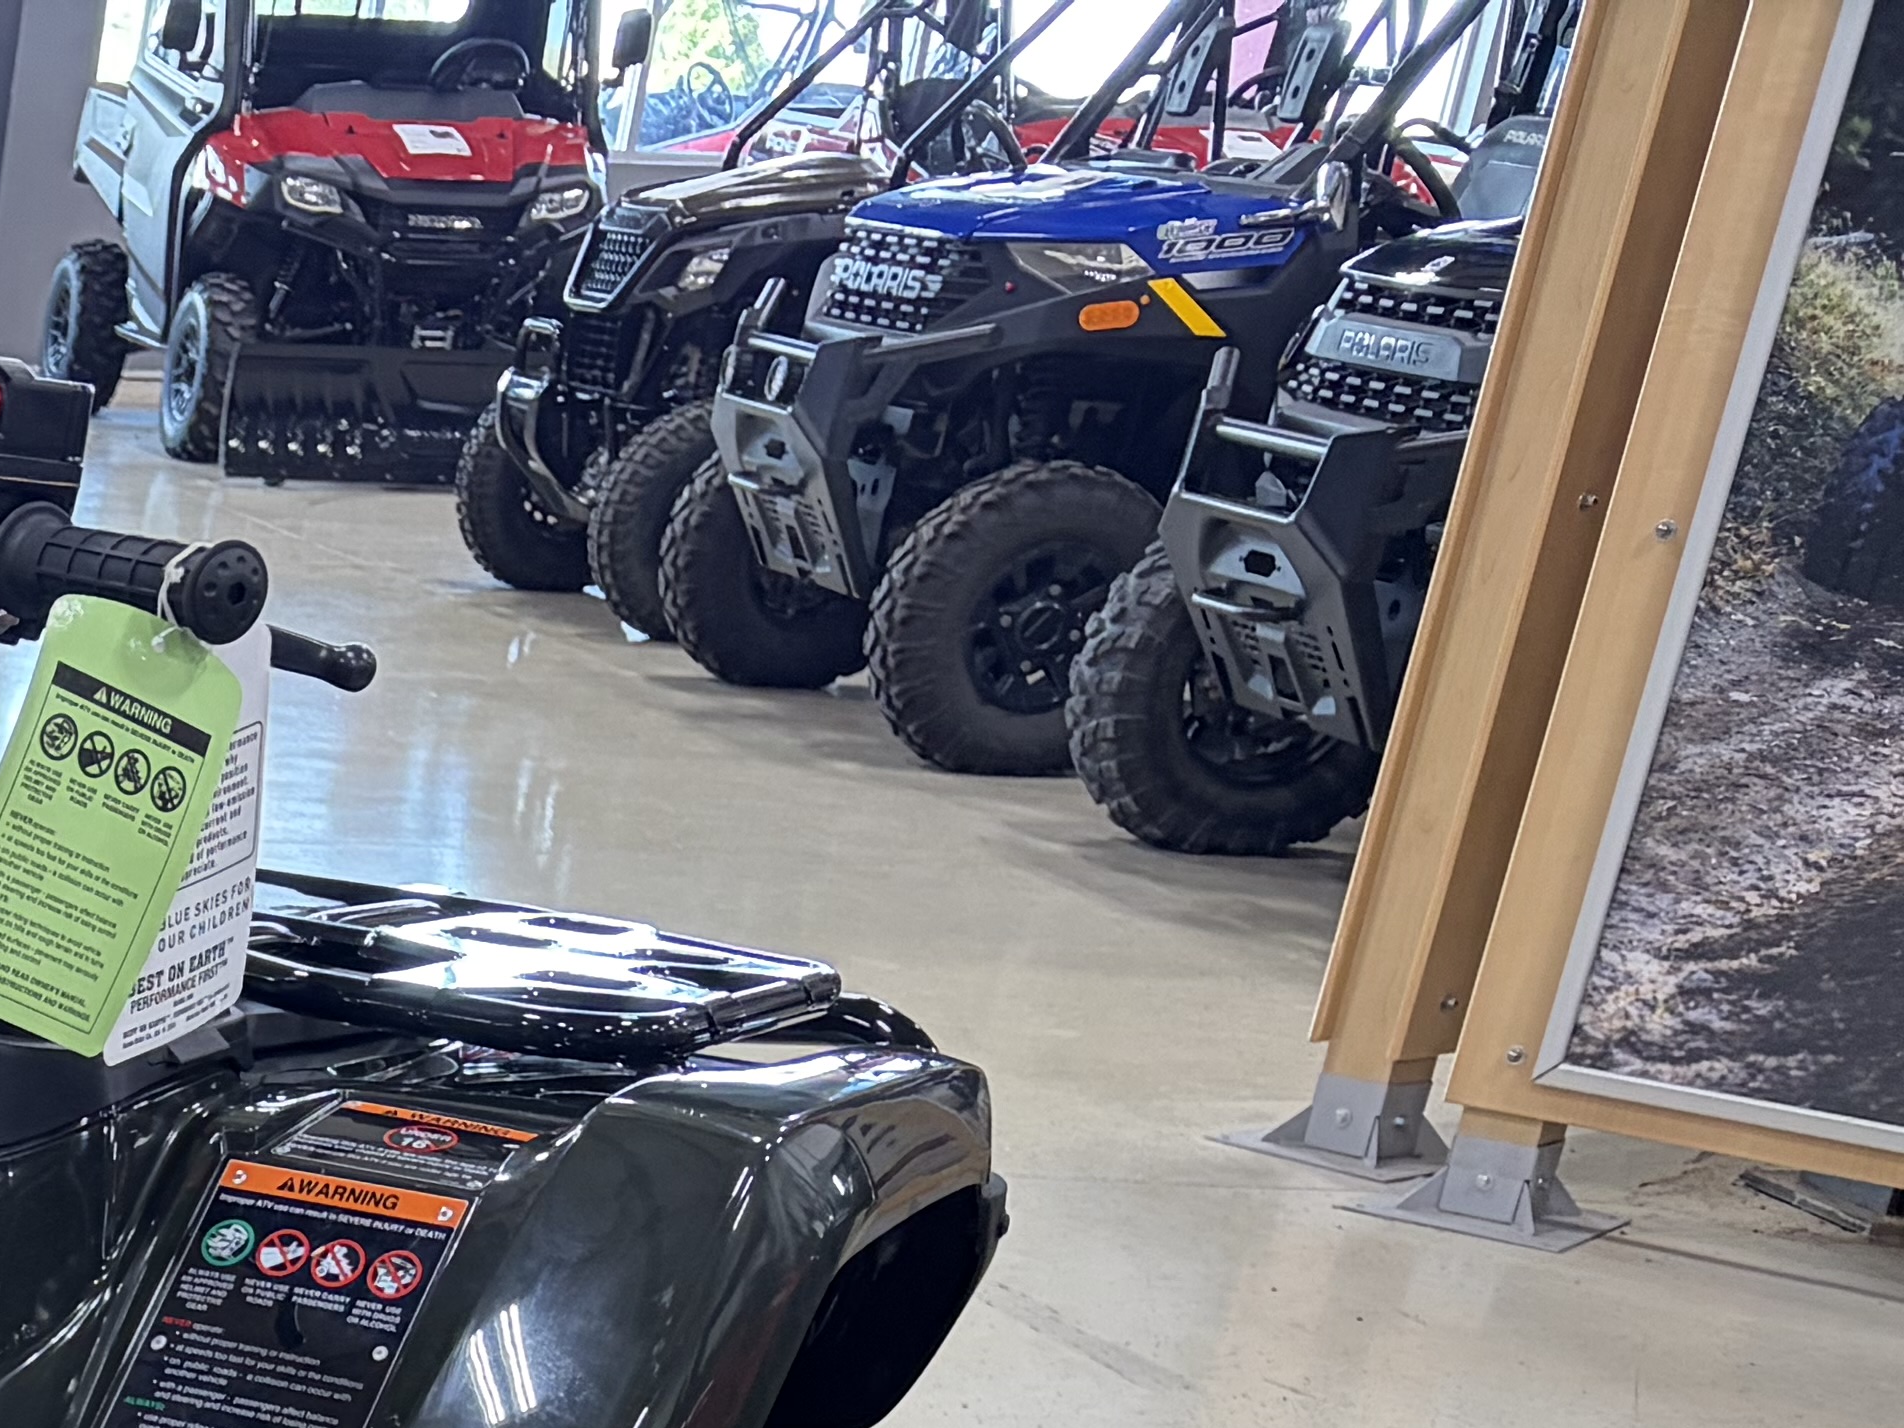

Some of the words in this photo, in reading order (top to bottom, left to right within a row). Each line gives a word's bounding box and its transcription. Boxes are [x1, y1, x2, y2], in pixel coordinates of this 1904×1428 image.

[1157, 227, 1295, 259] 1000
[831, 257, 926, 300] POLARIS
[1338, 328, 1434, 366] POLARIS
[106, 691, 174, 735] WARNING
[194, 889, 227, 917] SKIES
[230, 876, 252, 900] FOR
[157, 930, 185, 953] OUR
[190, 897, 250, 940] CHILDREN
[167, 960, 184, 983] ON
[130, 974, 197, 1014] PERFORMANCE
[295, 1178, 401, 1211] WARNING
